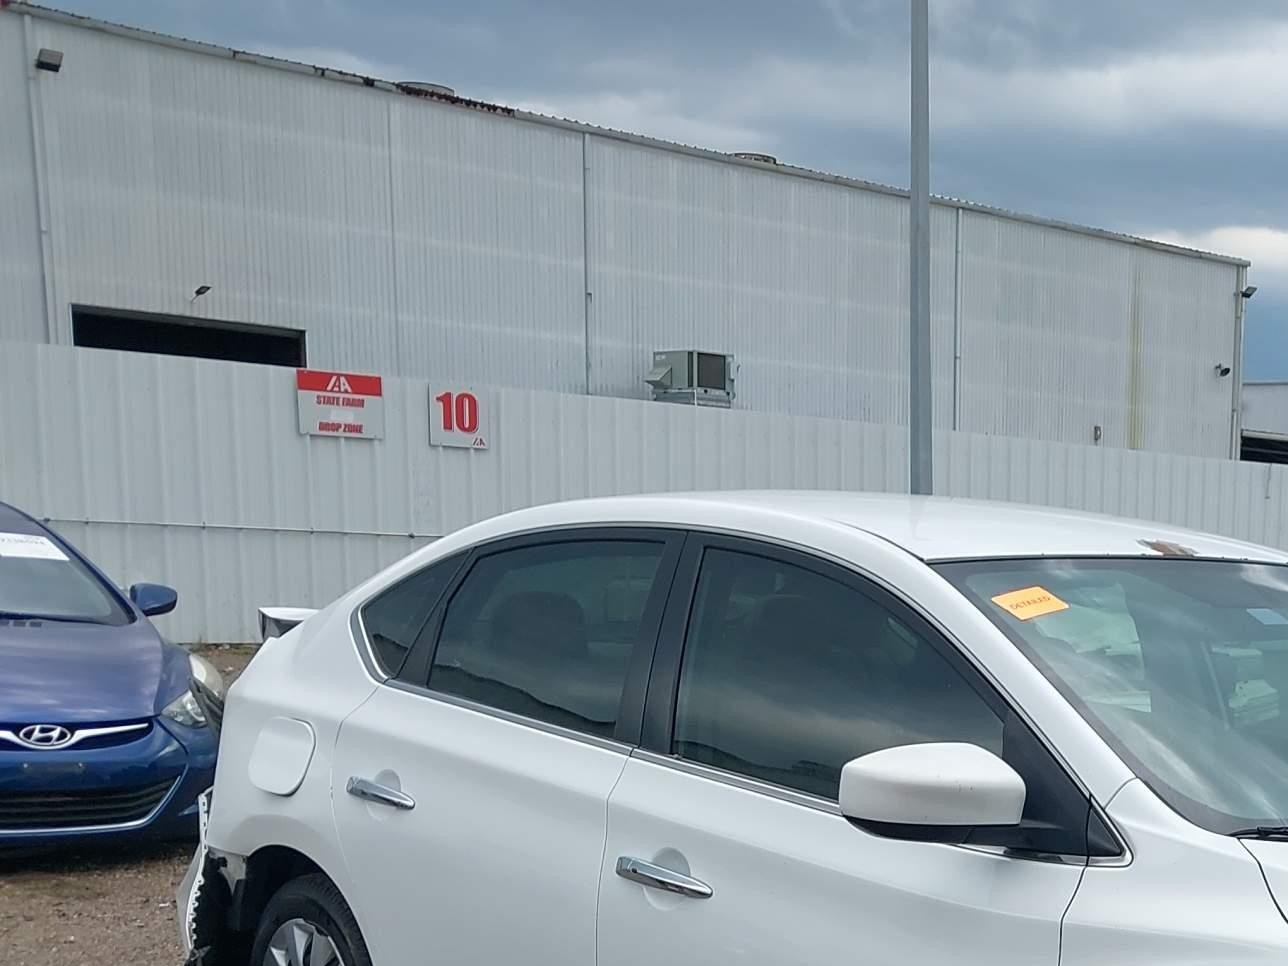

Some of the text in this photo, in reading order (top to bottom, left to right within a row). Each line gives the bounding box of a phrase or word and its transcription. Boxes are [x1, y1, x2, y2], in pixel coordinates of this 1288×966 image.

[316, 395, 364, 408] STATE FARM
[436, 391, 479, 434] 10
[318, 421, 363, 434] DROP ZONE
